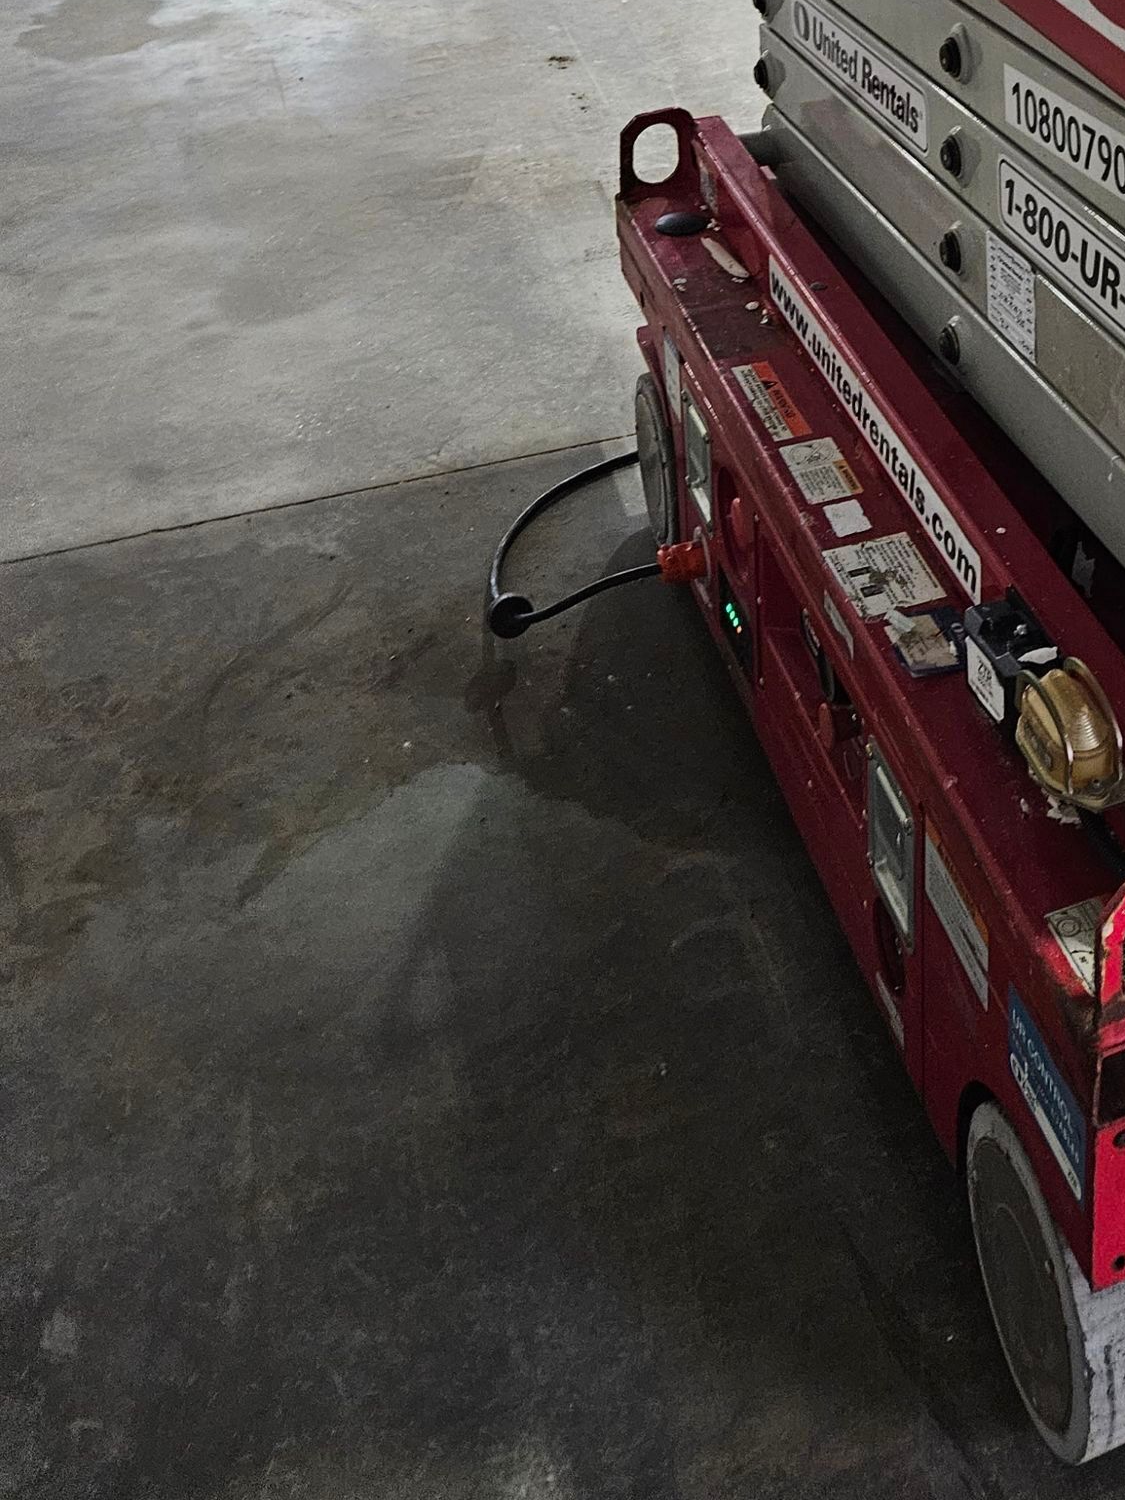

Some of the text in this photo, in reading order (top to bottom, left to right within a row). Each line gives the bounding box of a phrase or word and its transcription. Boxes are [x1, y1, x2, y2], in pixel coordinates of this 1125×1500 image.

[812, 14, 920, 134] United Rentals
[769, 272, 979, 595] www.unitedrentals.com
